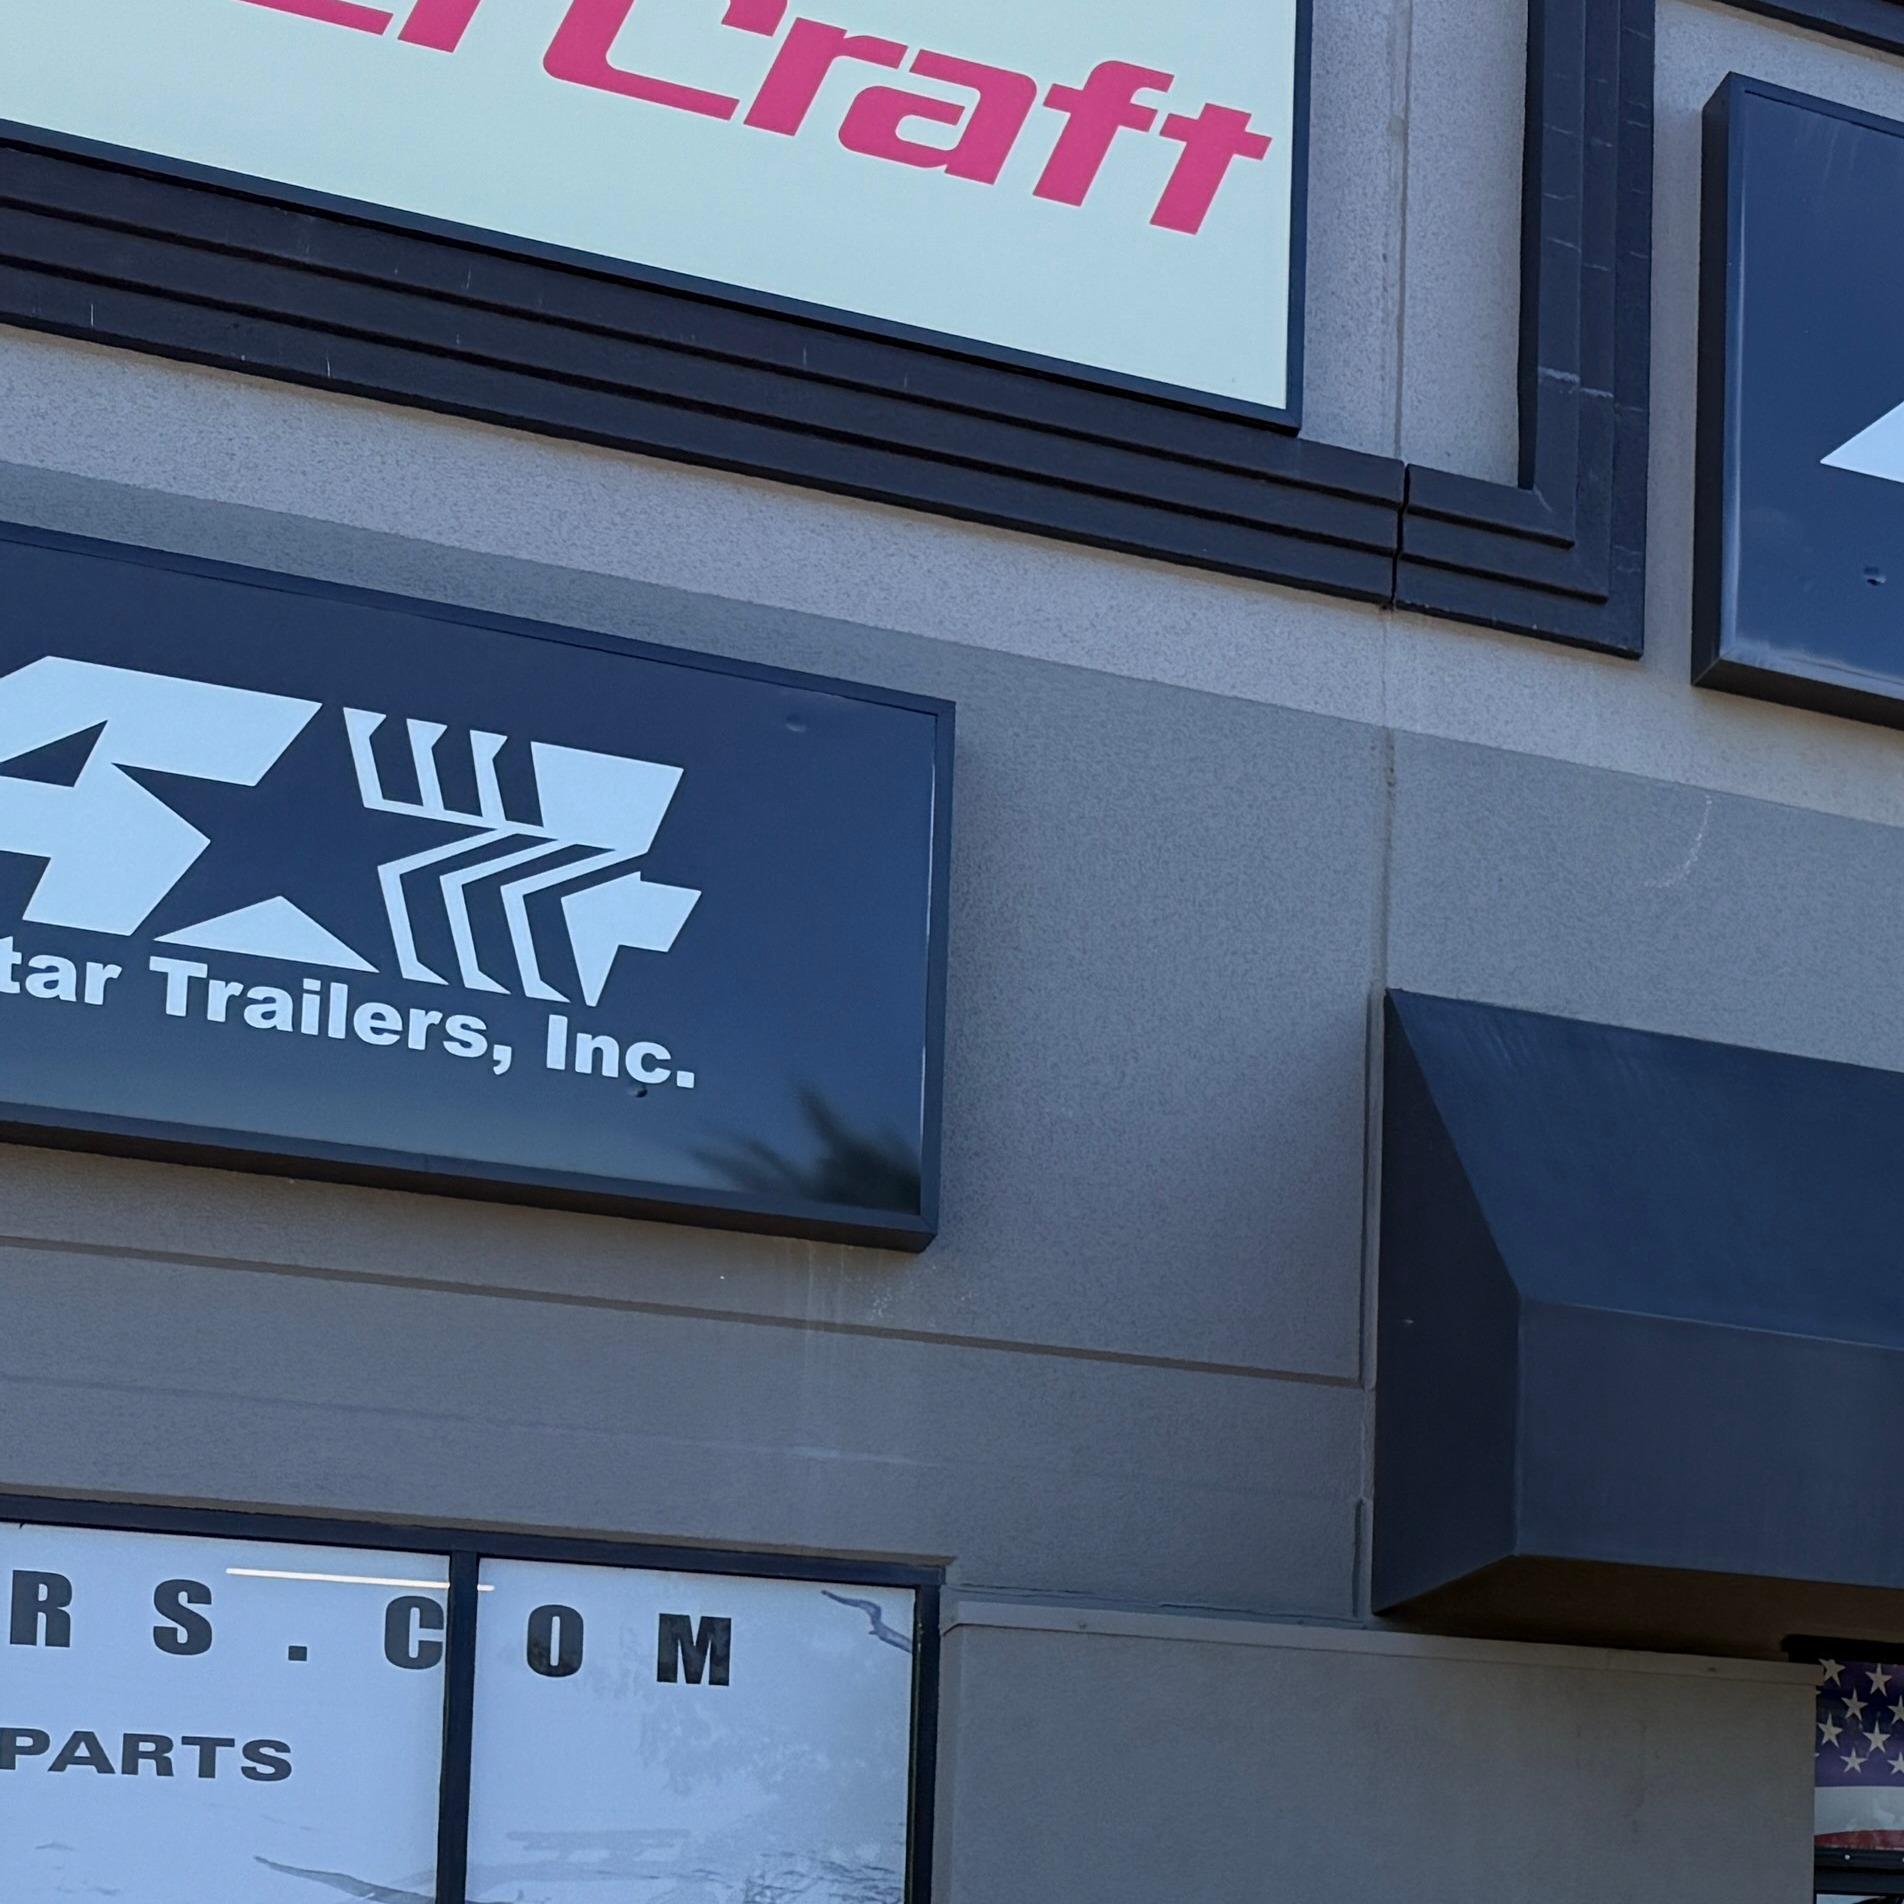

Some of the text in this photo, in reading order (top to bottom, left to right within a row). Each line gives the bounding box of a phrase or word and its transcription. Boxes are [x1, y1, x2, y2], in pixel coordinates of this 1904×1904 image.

[149, 955, 513, 1076] Trailers,
[545, 1015, 696, 1089] Inc.
[0, 1726, 293, 1782] PARTS
